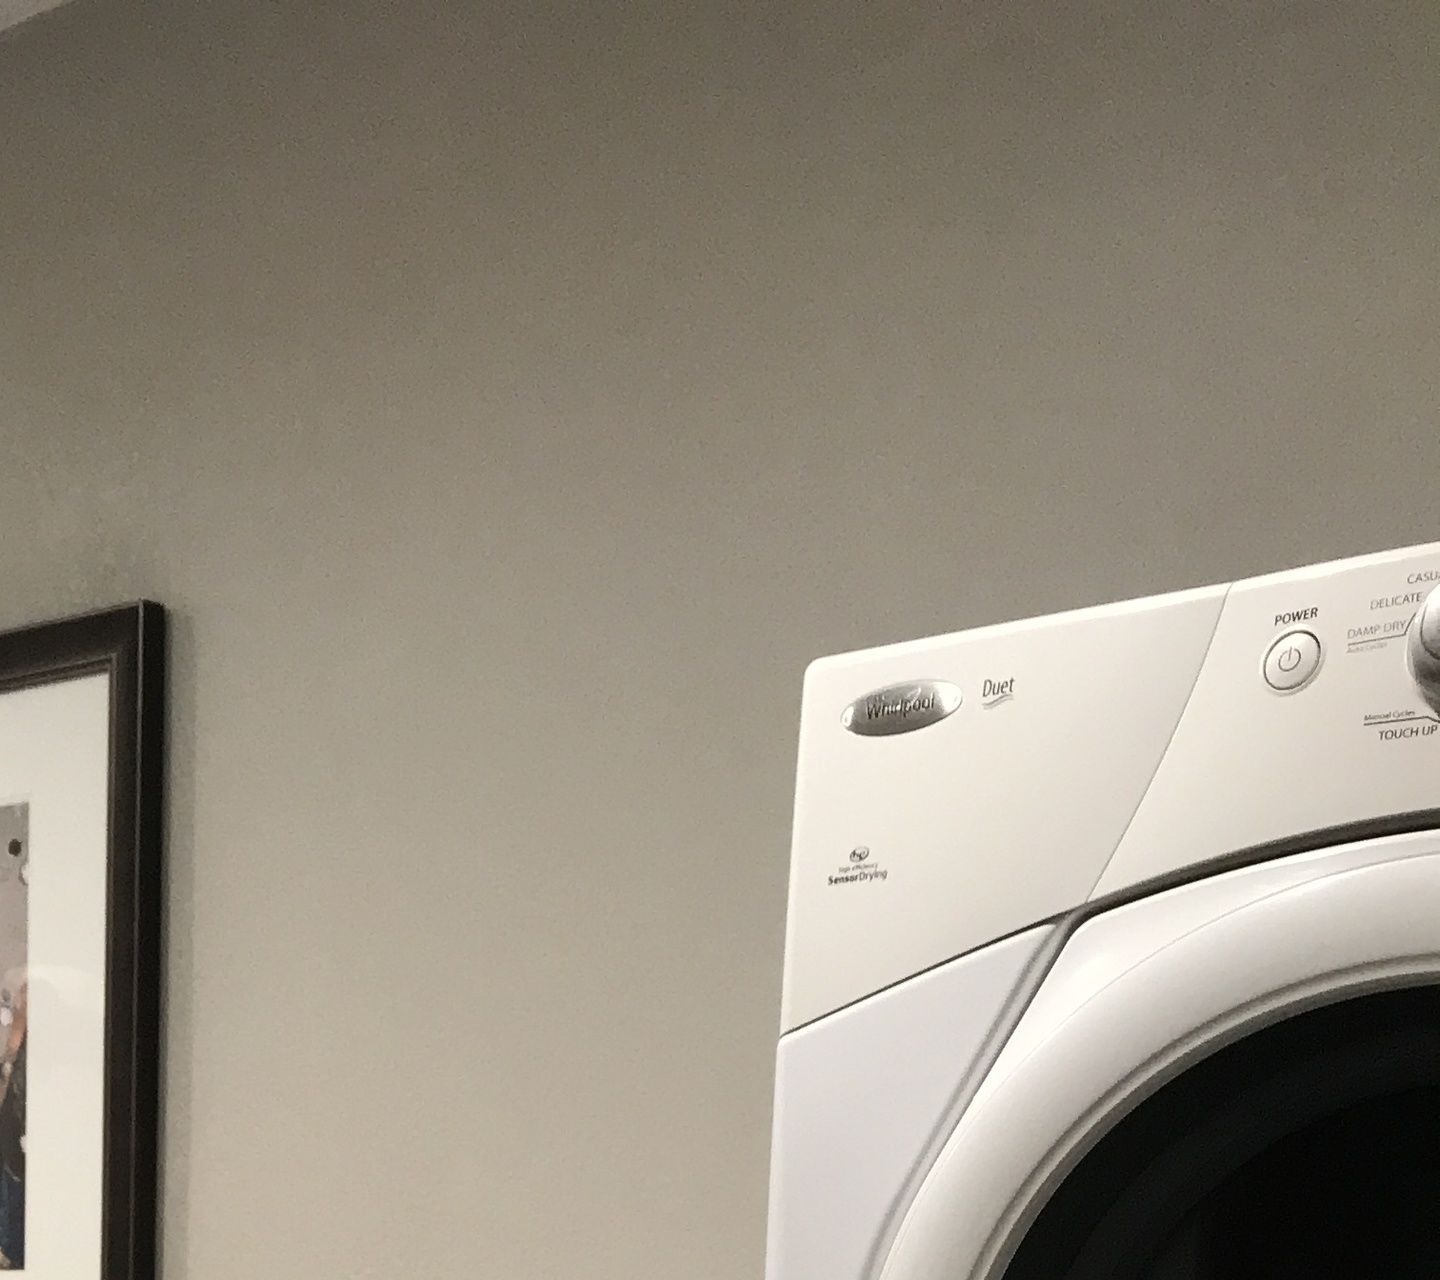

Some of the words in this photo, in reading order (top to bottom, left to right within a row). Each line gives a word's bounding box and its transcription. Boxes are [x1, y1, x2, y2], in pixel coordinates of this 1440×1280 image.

[1407, 569, 1440, 585] CASU
[1369, 592, 1424, 610] DELICATE
[1273, 607, 1319, 626] POWER
[1347, 624, 1381, 639] DAMP
[1383, 620, 1407, 634] DRY
[982, 677, 1015, 698] Duet
[865, 693, 935, 721] Whirlpool
[1363, 711, 1392, 722] Manual
[1393, 709, 1416, 720] Cycles
[1378, 726, 1419, 741] TOUCH
[1422, 724, 1438, 737] UP
[827, 868, 888, 886] SensorDrying
